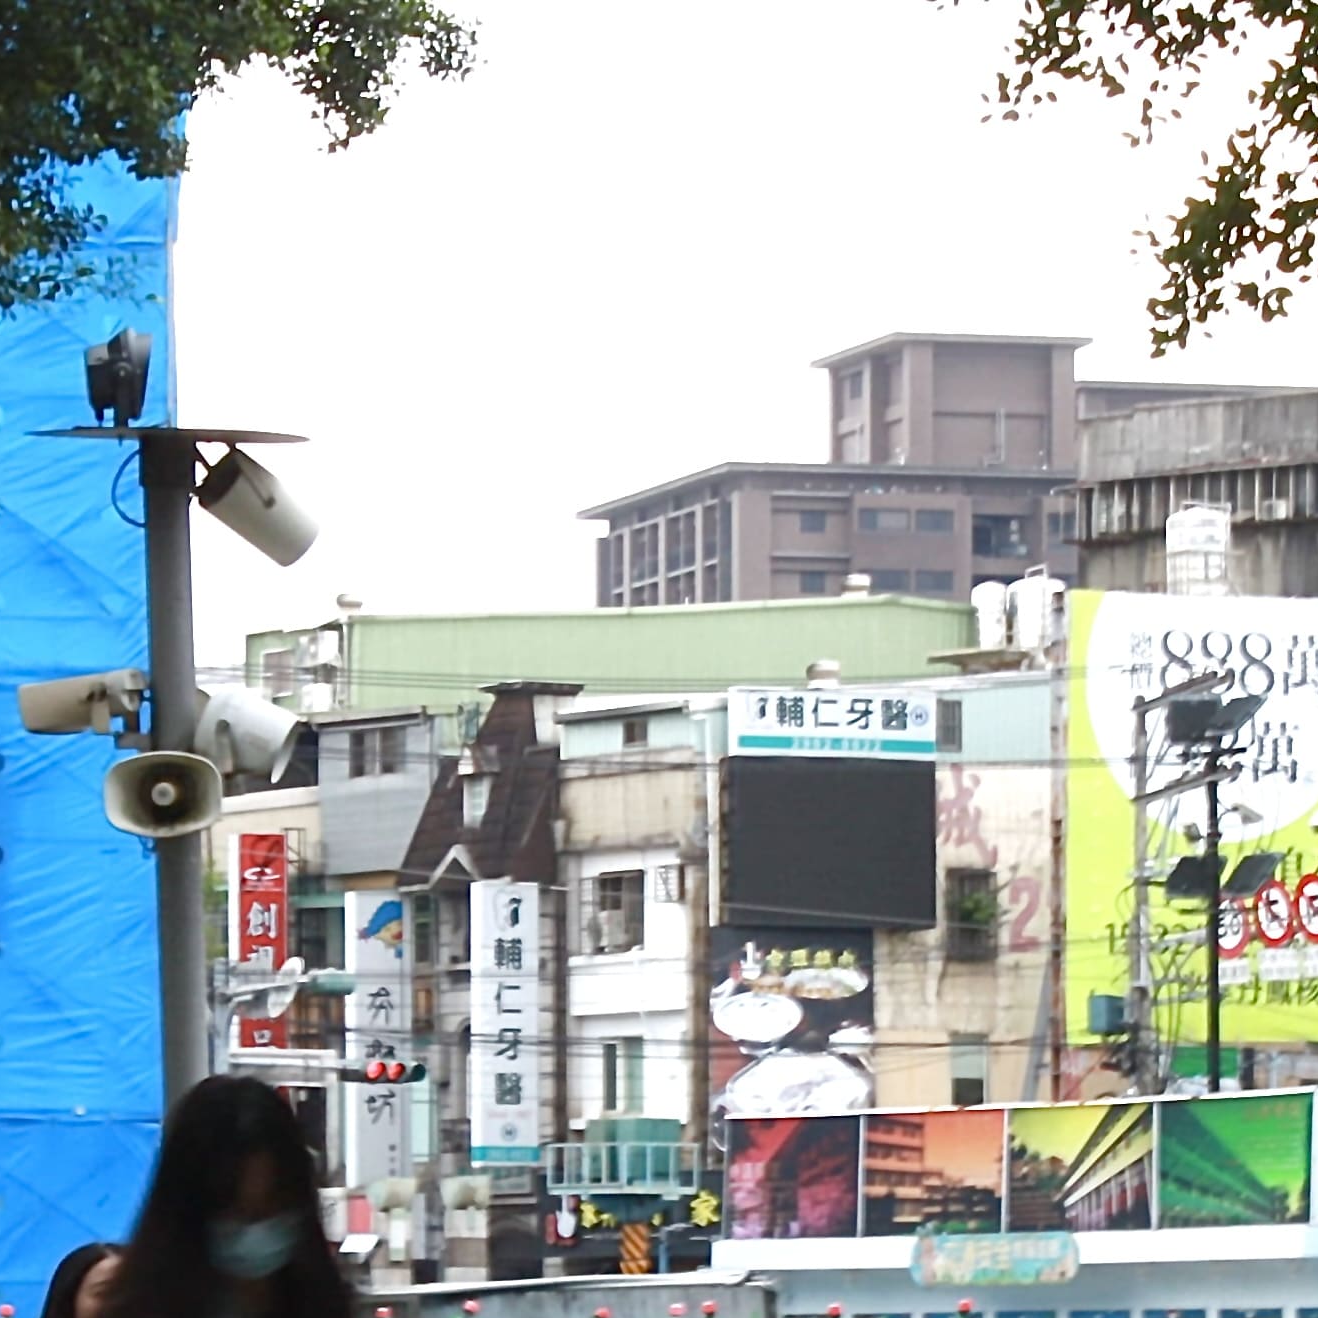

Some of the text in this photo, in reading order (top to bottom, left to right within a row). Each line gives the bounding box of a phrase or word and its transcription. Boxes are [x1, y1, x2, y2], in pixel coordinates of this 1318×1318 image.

[776, 695, 909, 731] 輔仁牙醫
[494, 937, 523, 1106] 輔仁牙醫
